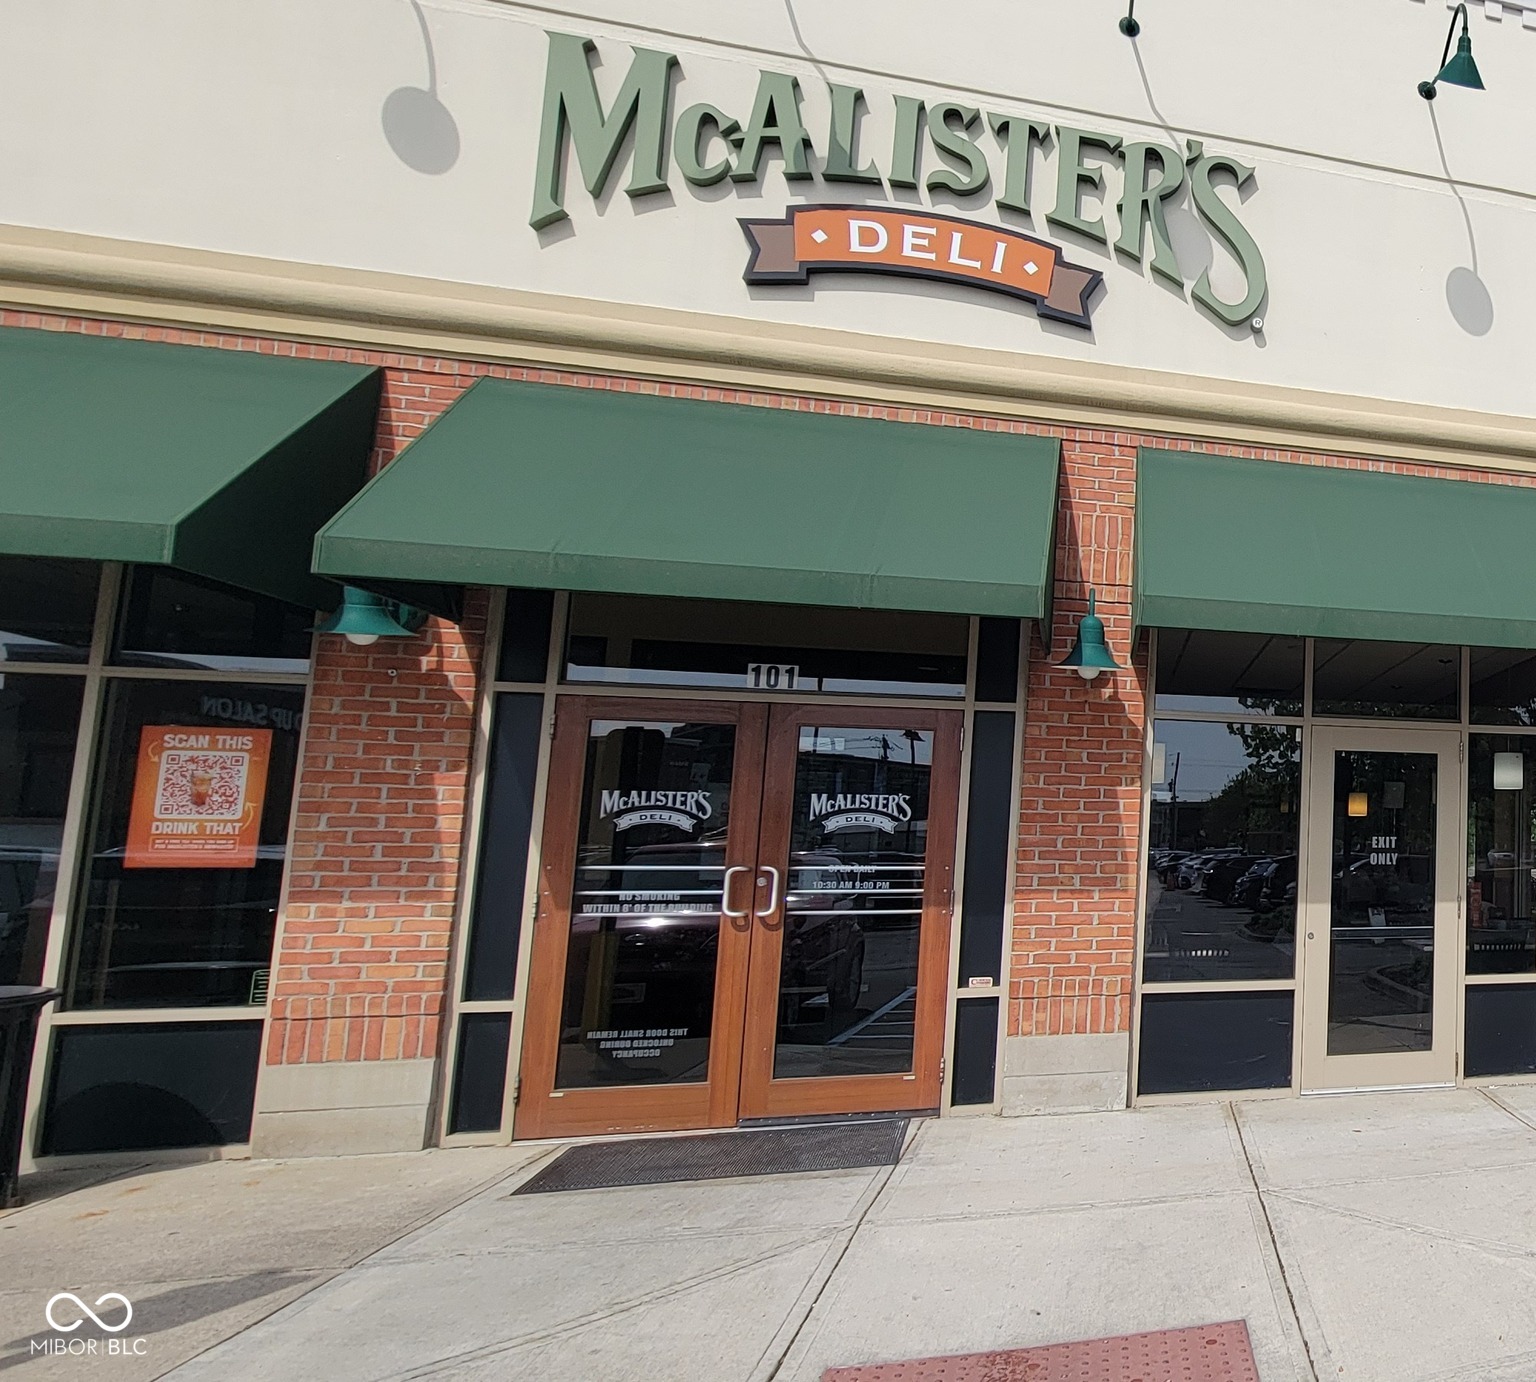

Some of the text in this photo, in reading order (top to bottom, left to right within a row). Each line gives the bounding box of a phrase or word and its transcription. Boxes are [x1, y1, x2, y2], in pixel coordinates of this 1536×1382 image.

[847, 218, 1008, 274] DELI
[751, 664, 796, 689] 101
[163, 733, 254, 750] SCAN THIS
[639, 813, 672, 821] DELI
[151, 821, 243, 835] DRINK THAT
[1371, 836, 1398, 849] EXIT
[1370, 852, 1399, 865] ONLY
[813, 881, 890, 889] 10:30 AM 9:00 PM
[582, 904, 620, 913] WITHIN
[634, 904, 647, 912] OF
[648, 903, 668, 912] THE
